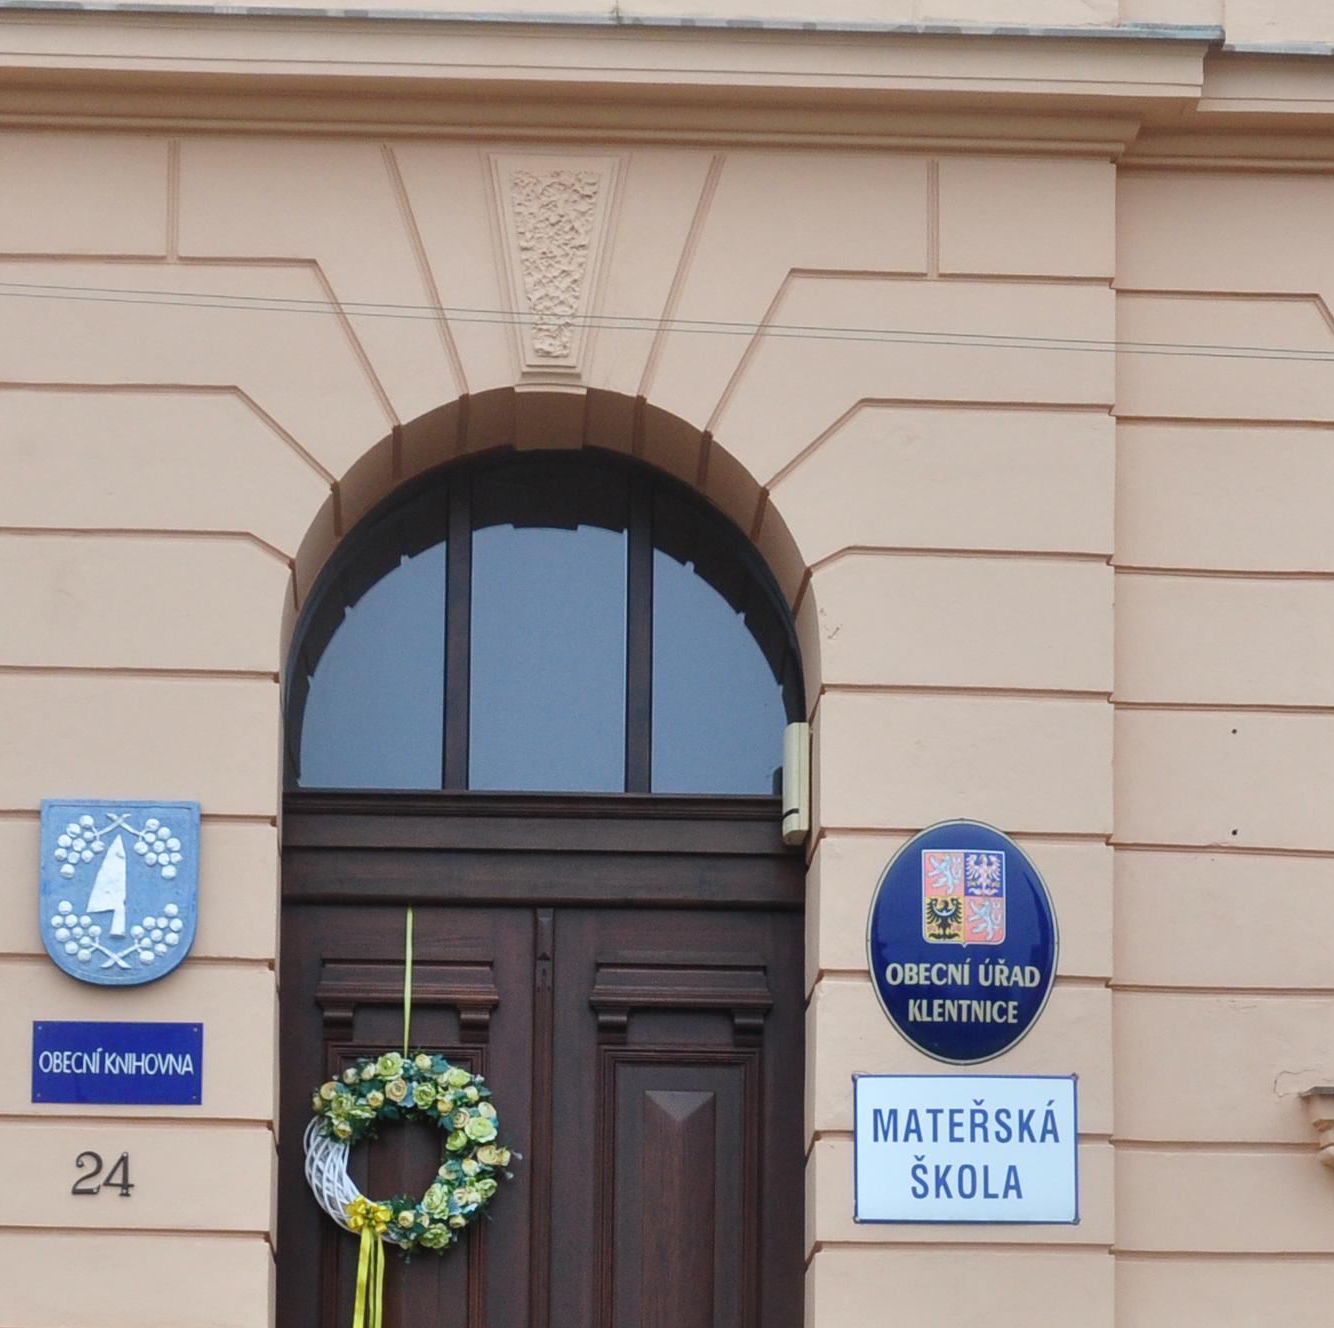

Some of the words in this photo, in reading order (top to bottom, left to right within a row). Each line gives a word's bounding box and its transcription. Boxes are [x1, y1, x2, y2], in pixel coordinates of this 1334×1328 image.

[885, 957, 971, 987] OBECNÍ
[978, 958, 1041, 989] ÚŘAD
[908, 998, 1019, 1024] KLENTNICE
[38, 1047, 103, 1074] OBECNÍ
[104, 1053, 194, 1075] KNIHOVNA
[872, 1098, 1061, 1144] MATEŘSKÁ
[70, 1150, 136, 1197] 24
[910, 1154, 1024, 1200] ŠKOLA
